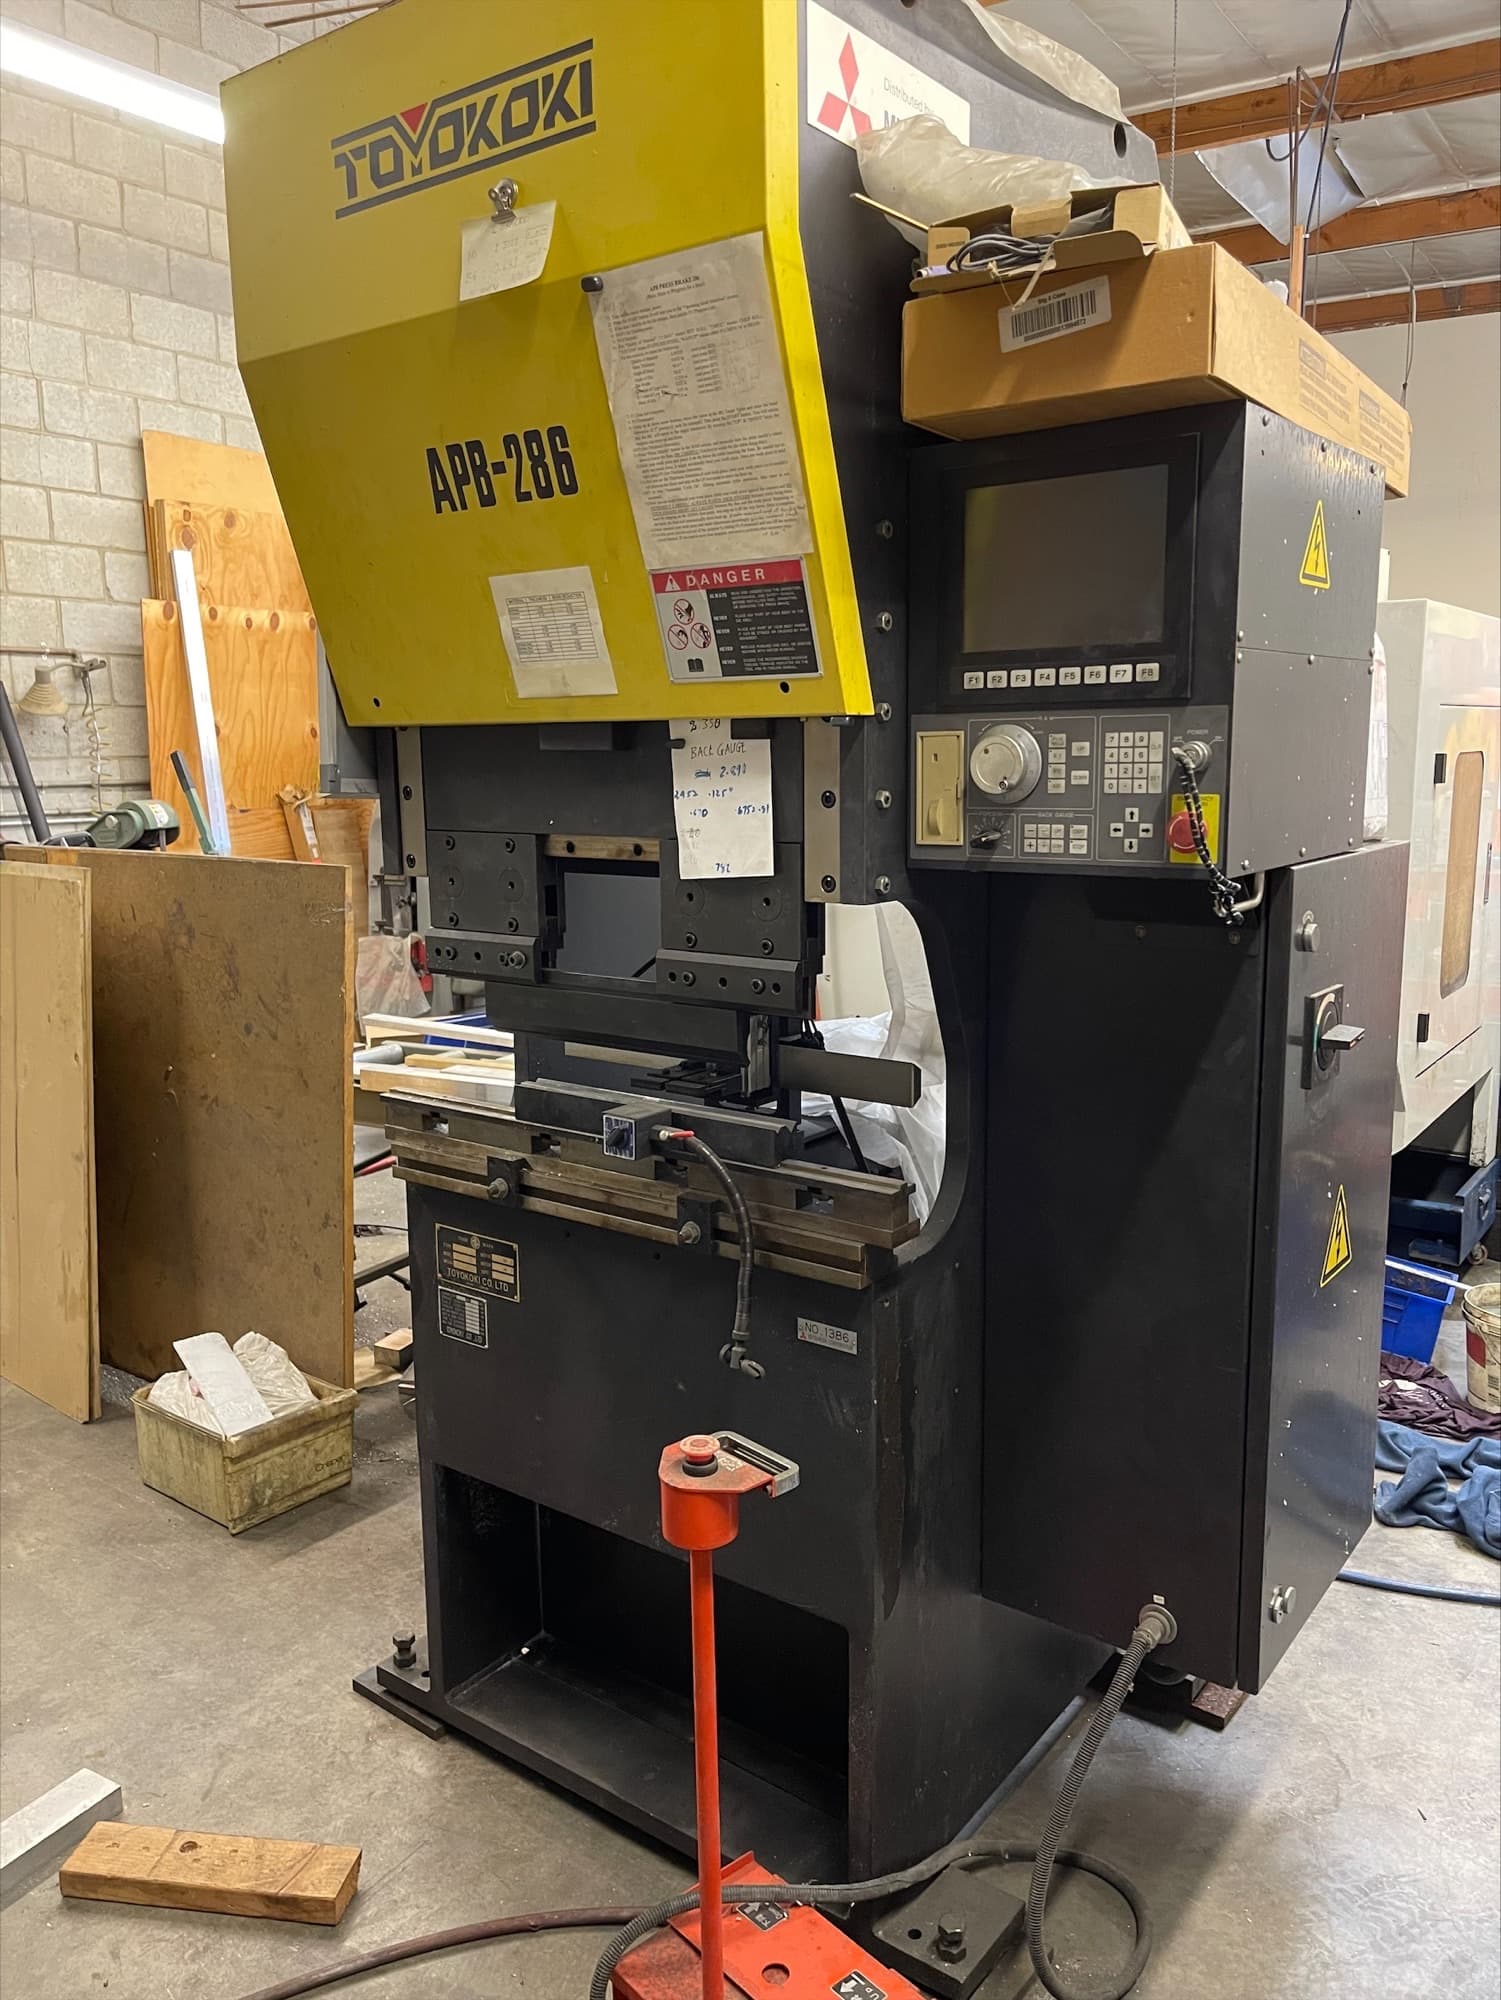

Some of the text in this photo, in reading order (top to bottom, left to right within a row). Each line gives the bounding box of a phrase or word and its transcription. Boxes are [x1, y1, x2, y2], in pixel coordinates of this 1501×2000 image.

[333, 58, 594, 200] TOYOKOKI
[426, 425, 579, 514] APB-286
[686, 568, 766, 588] DANGER
[968, 668, 1153, 685] F1 F2 F3 F4 F5 F6 F7 F8
[717, 742, 746, 757] GAUGE
[447, 1267, 481, 1284] TOYOKOKI
